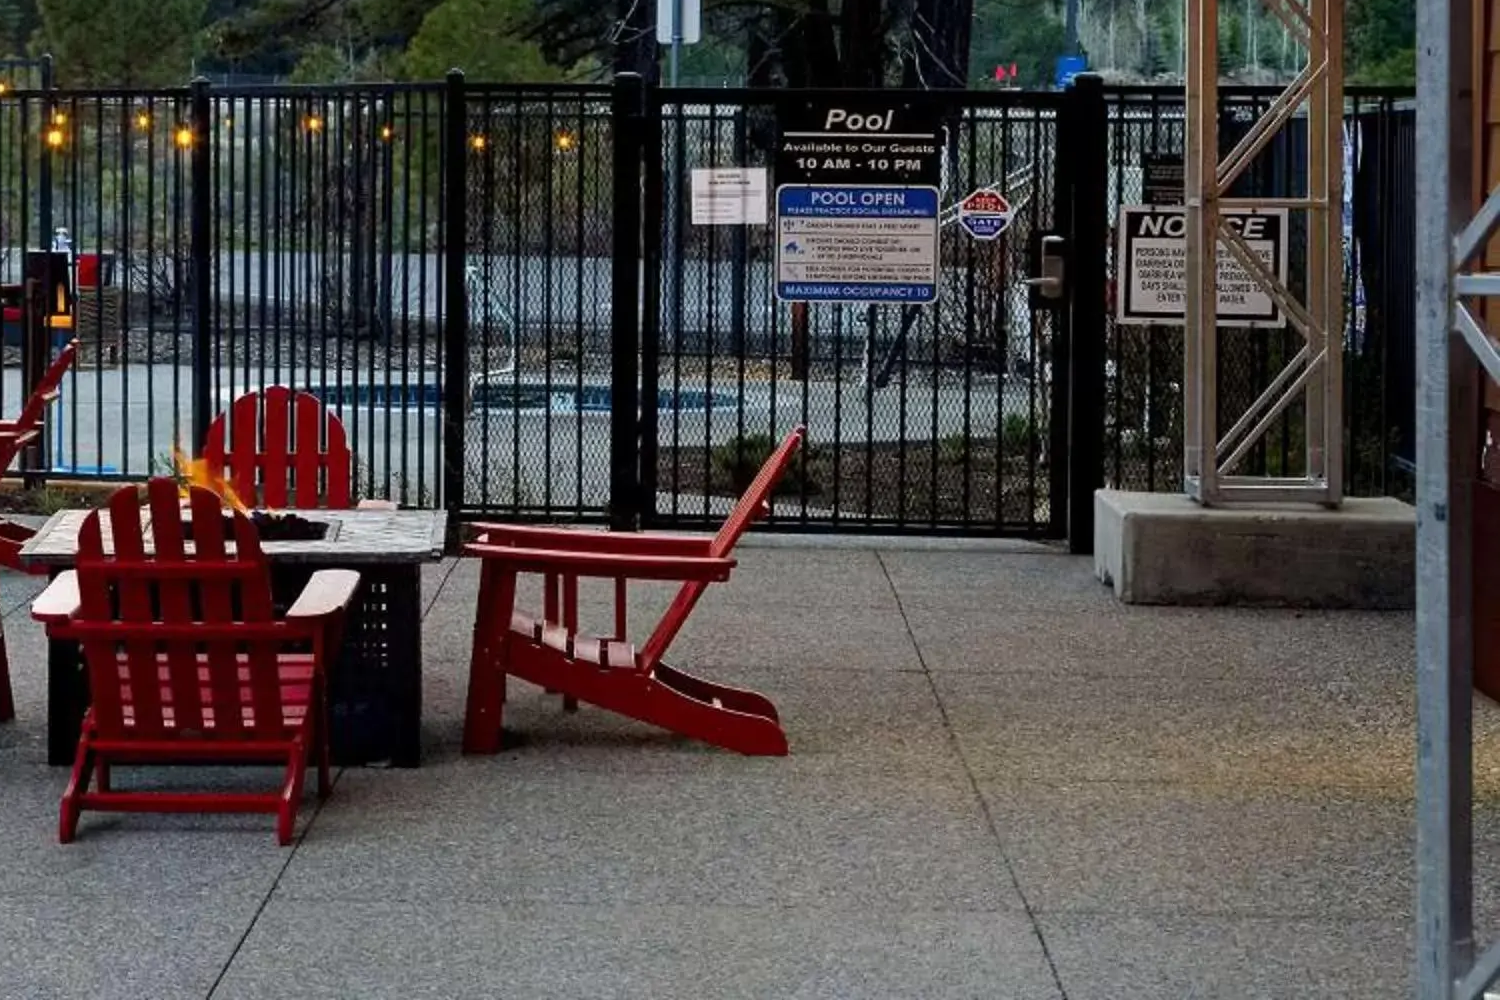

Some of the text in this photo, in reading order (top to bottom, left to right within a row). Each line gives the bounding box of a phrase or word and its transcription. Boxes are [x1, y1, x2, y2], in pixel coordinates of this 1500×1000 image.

[824, 108, 895, 131] Pool
[784, 142, 935, 153] Available to Our Guests
[796, 157, 817, 169] 10
[822, 158, 851, 169] AM
[867, 159, 889, 170] 10
[894, 159, 922, 171] PM
[811, 191, 906, 206] POOL OPEN
[1137, 215, 1268, 238] NOCE
[785, 285, 929, 297] MAXIMUM OCCUPANCY 10
